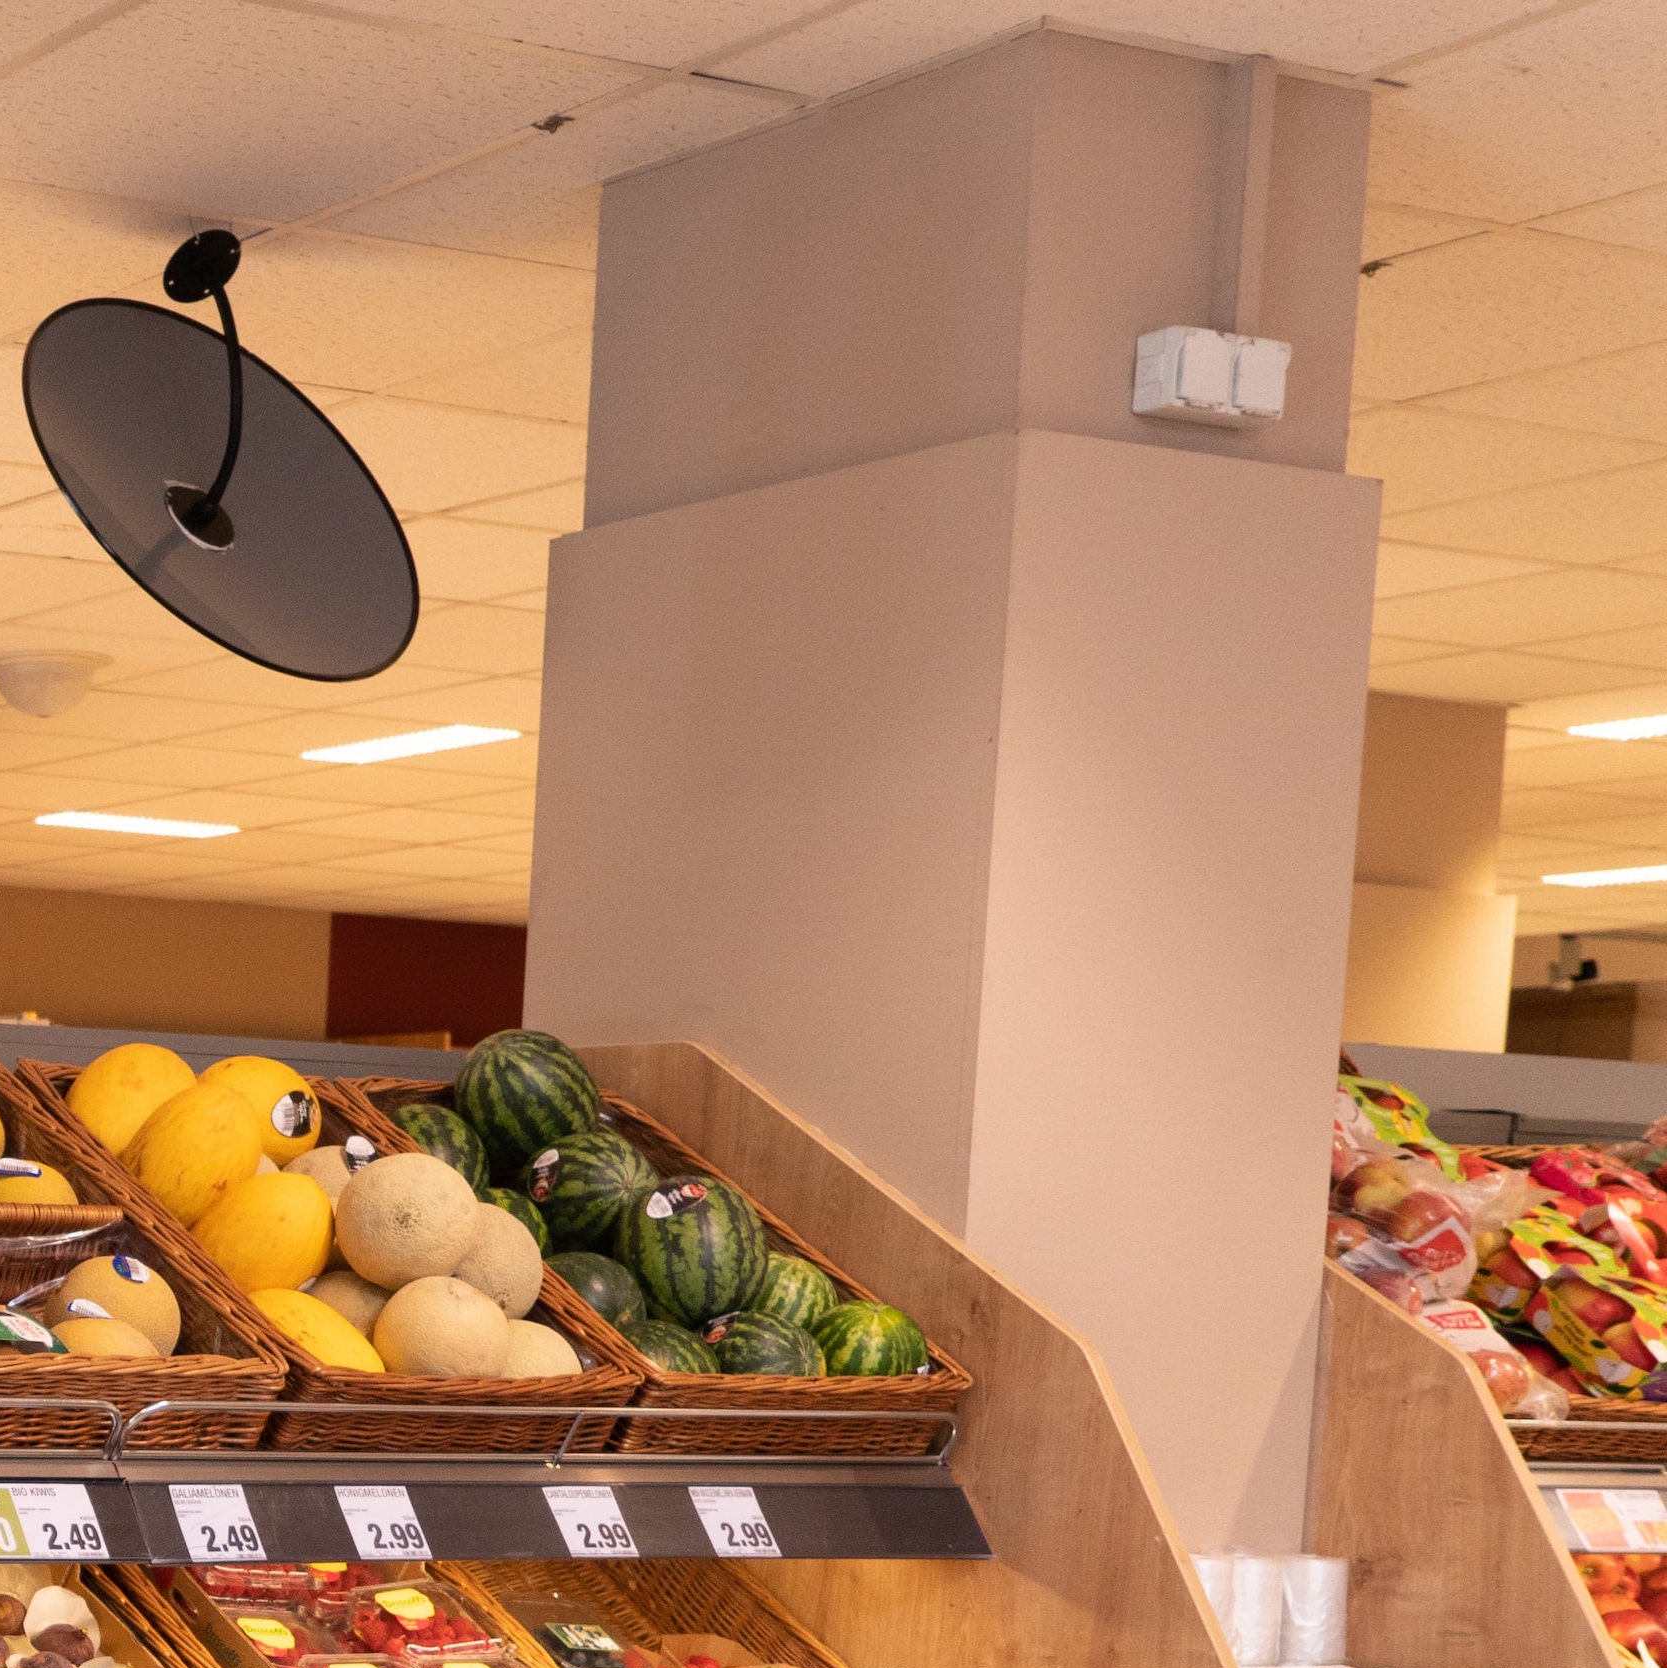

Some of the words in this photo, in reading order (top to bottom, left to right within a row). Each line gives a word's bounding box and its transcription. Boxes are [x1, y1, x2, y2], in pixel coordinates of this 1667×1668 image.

[11, 1487, 27, 1497] BIO
[29, 1487, 57, 1497] KIWIS
[171, 1488, 239, 1499] GALIAMELONEN
[338, 1489, 407, 1498] HONIGMELONEN
[42, 1522, 102, 1550] 2.49
[201, 1525, 259, 1552] 2.49
[367, 1523, 425, 1549] 2.99
[577, 1523, 632, 1548] 2.99
[720, 1522, 773, 1547] 2.99
